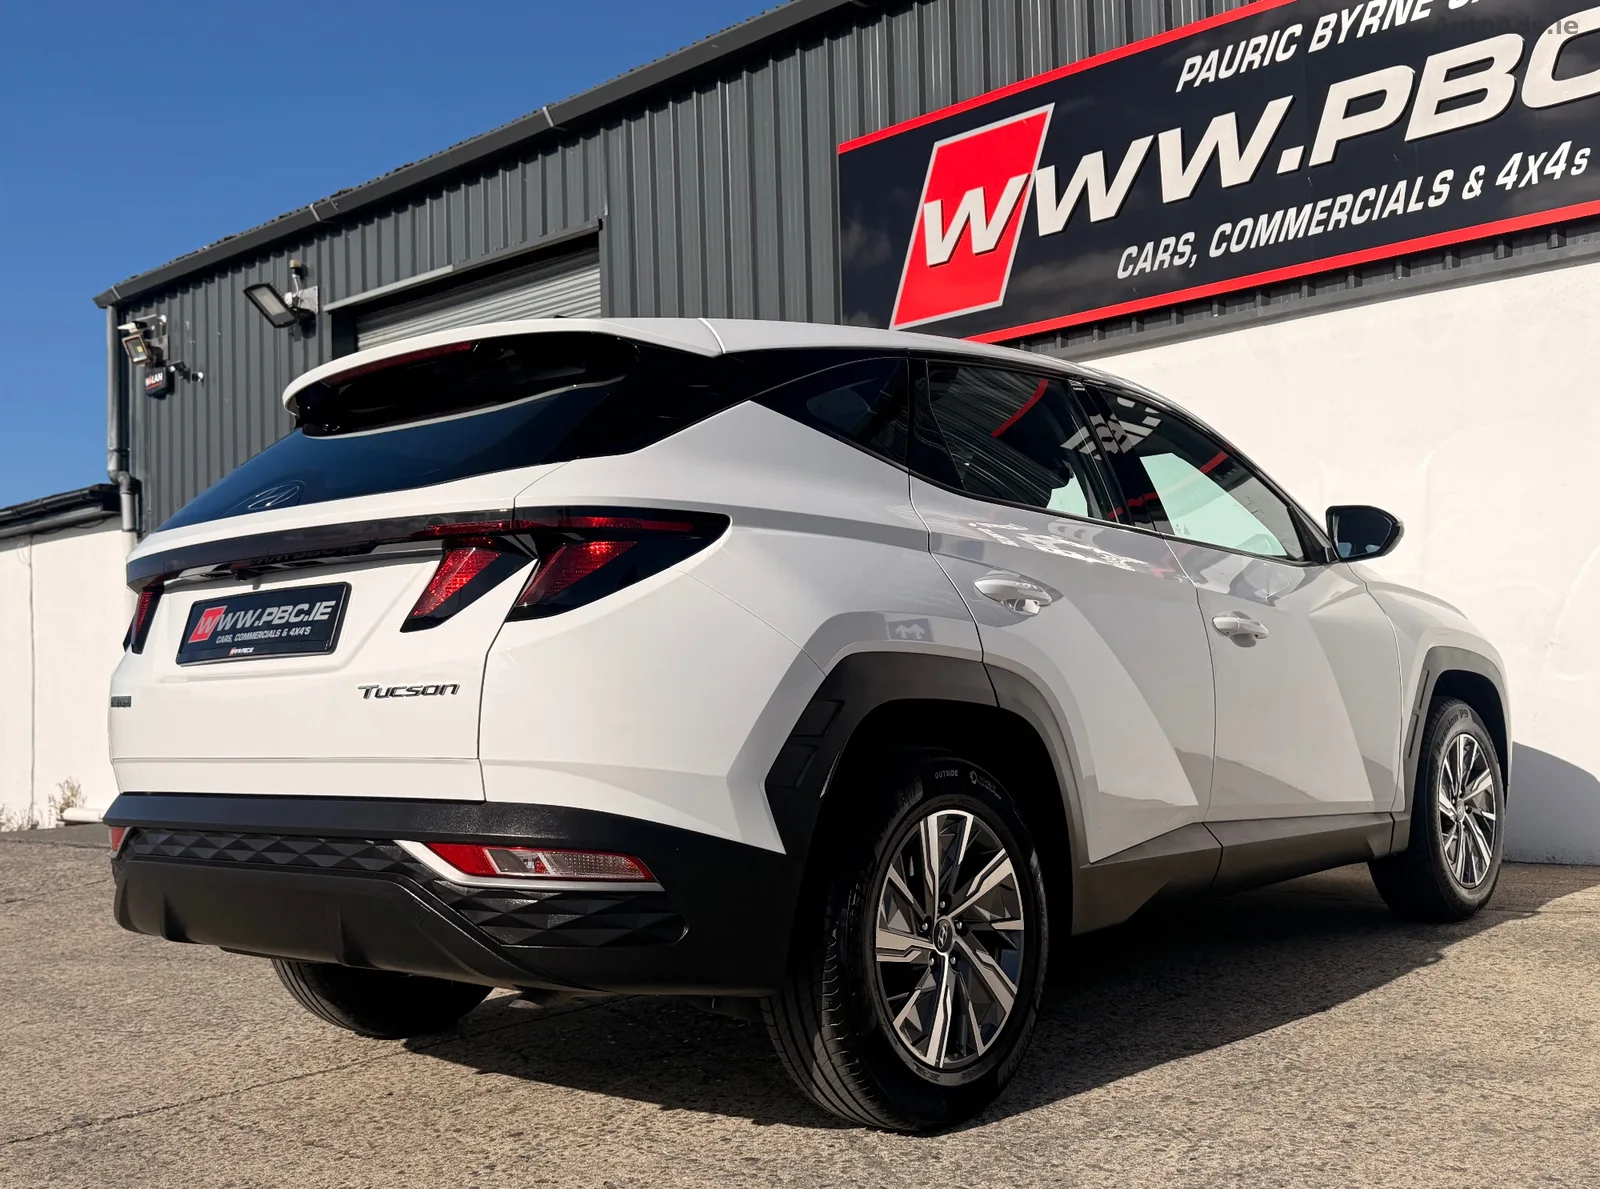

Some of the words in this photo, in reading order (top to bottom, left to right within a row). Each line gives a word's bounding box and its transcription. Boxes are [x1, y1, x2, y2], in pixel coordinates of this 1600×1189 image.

[1176, 23, 1303, 93] PAURIC
[1307, 0, 1432, 54] BYRNE
[1116, 231, 1199, 280] CARS,
[1208, 168, 1455, 258] COMMERCIALS
[1462, 164, 1486, 200] &
[197, 600, 337, 635] WWW.PBC.IE
[216, 633, 233, 644] CARS,
[234, 628, 281, 642] COMMERCIALS
[934, 769, 959, 779] OUTSIDE
